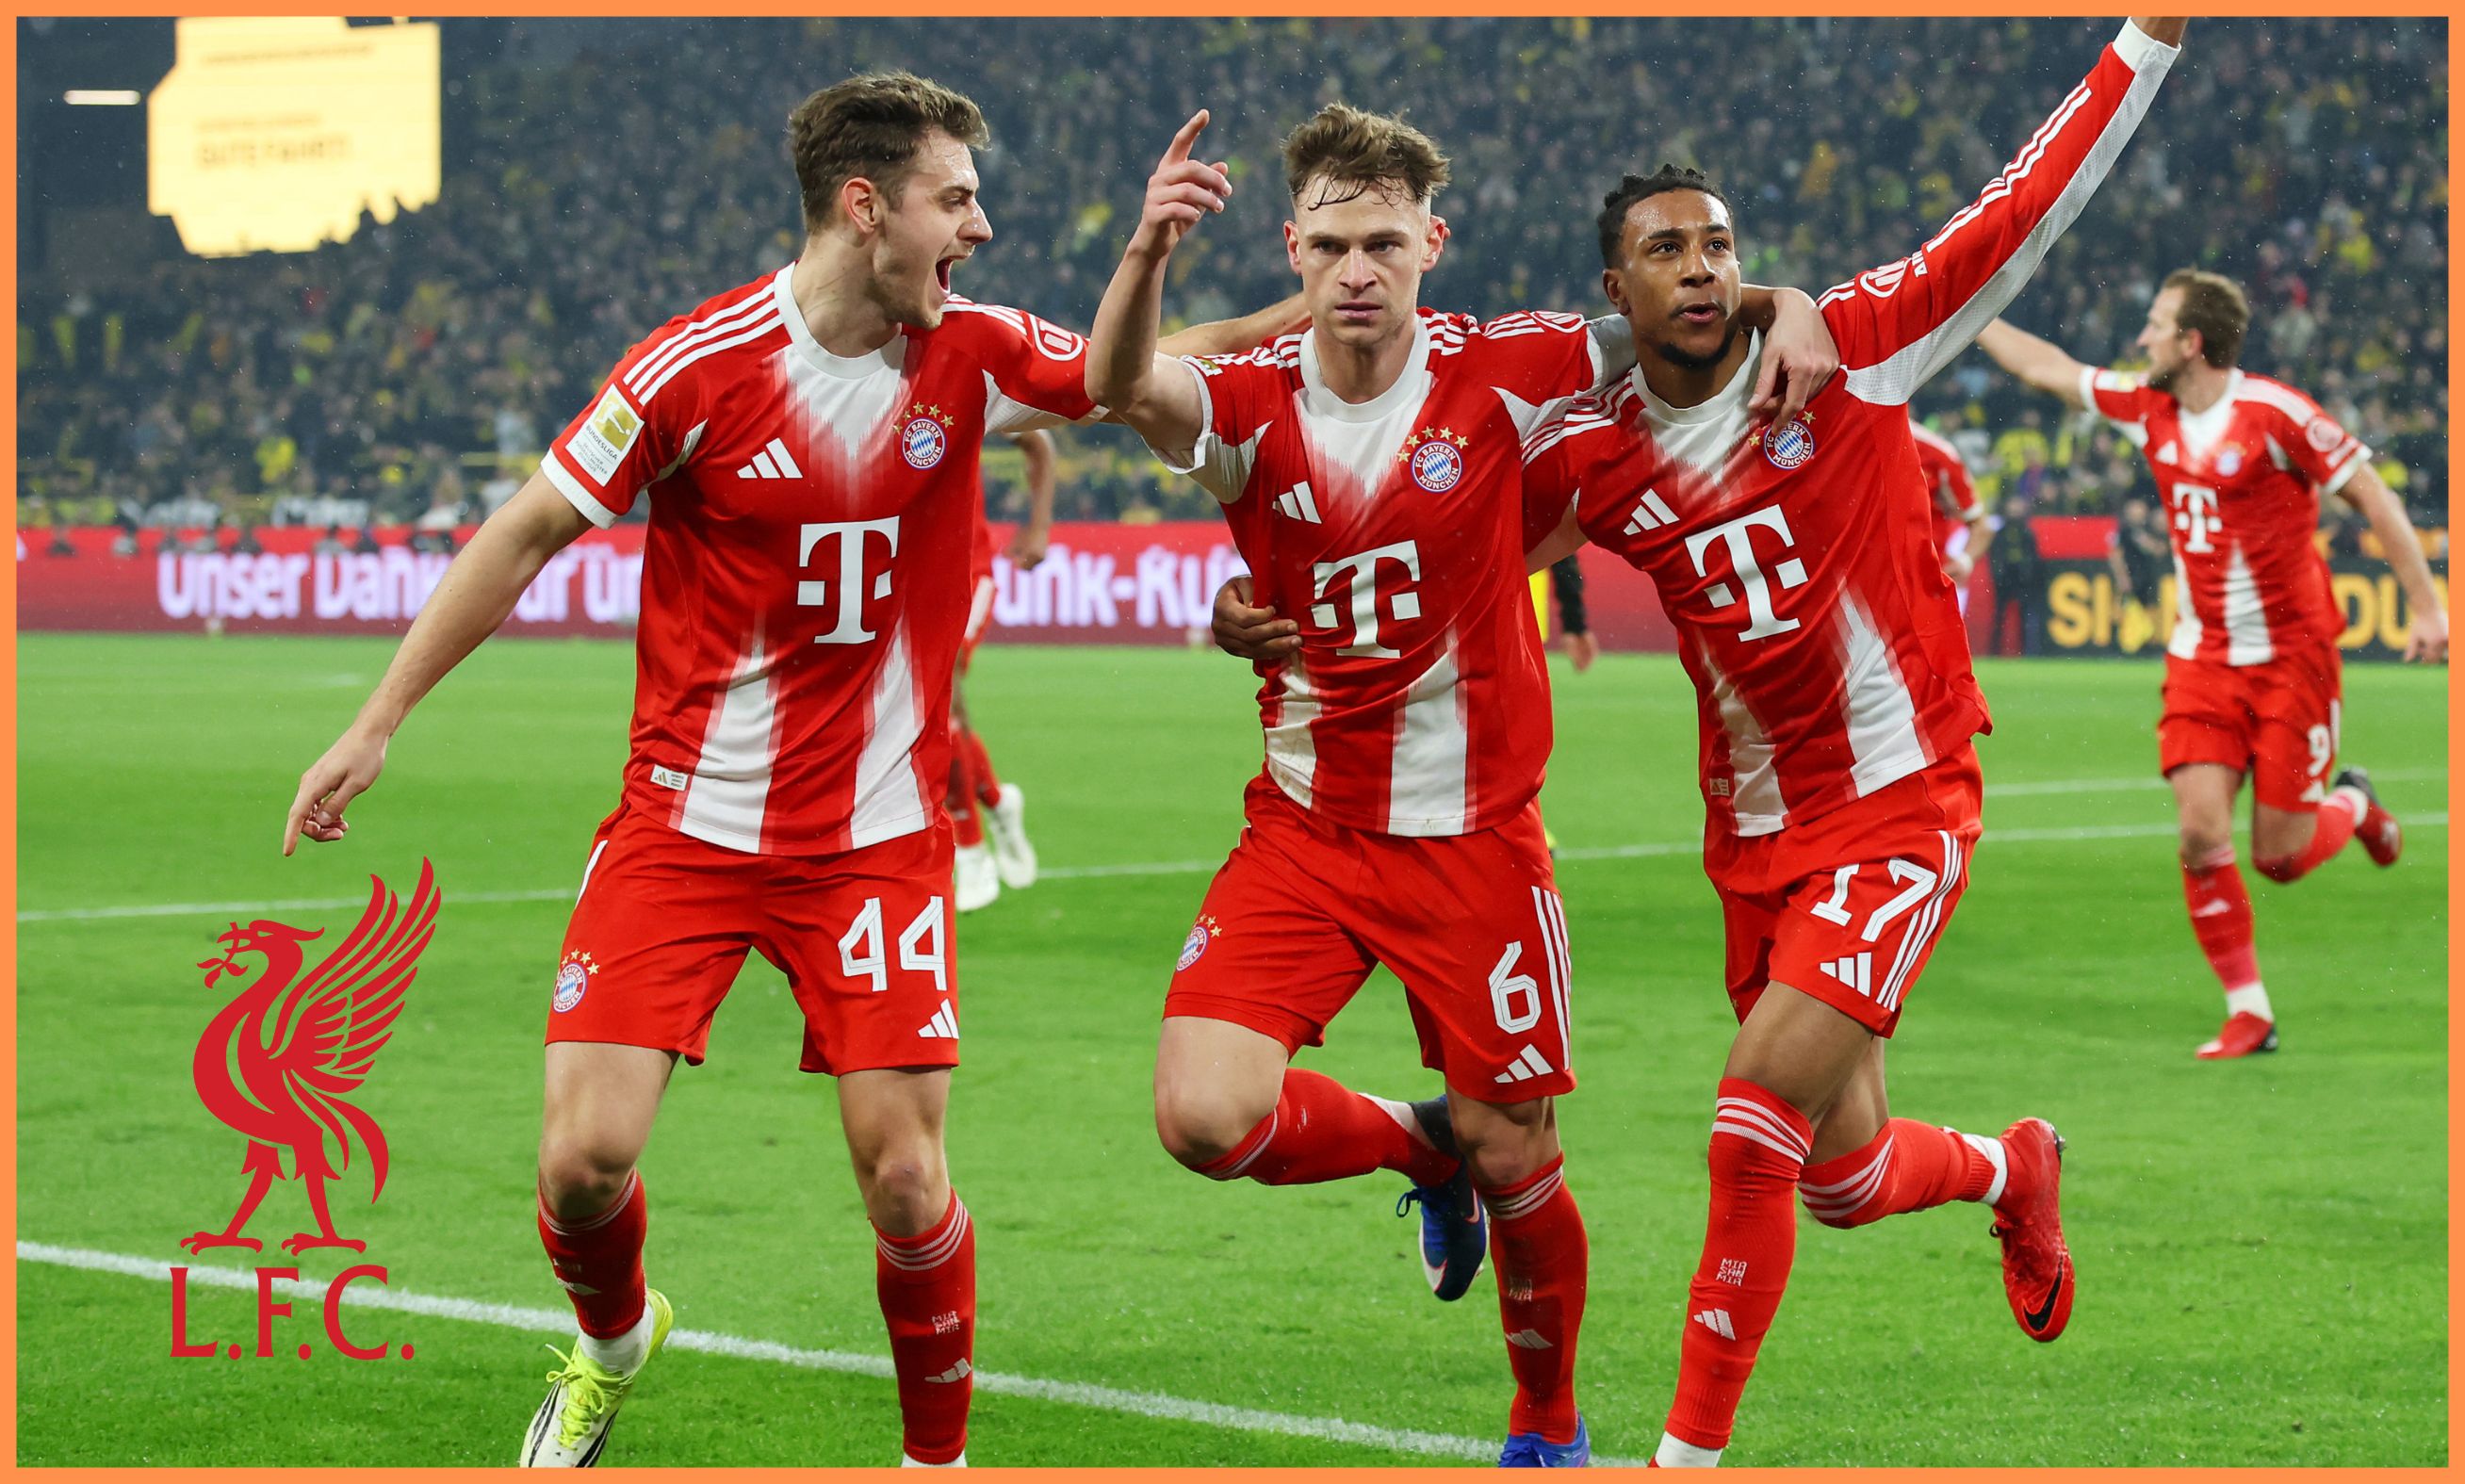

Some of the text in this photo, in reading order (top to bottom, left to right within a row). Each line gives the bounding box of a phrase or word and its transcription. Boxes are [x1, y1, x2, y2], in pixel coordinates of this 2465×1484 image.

[585, 424, 618, 461] BUNDESLIGA
[911, 421, 940, 438] BAYERN
[1415, 445, 1456, 467] FC BAYERN
[1767, 436, 1773, 448] FC
[156, 550, 310, 620] Unser
[797, 515, 900, 644] T
[1311, 539, 1421, 659] T
[1685, 504, 1809, 643] T
[2307, 723, 2331, 777] 9
[1810, 856, 1937, 942] 17
[838, 896, 947, 991] 44
[1488, 940, 1542, 1034] 6
[1716, 1273, 1742, 1287] MIA
[1719, 1265, 1745, 1280] SAN
[1721, 1258, 1747, 1270] MIA
